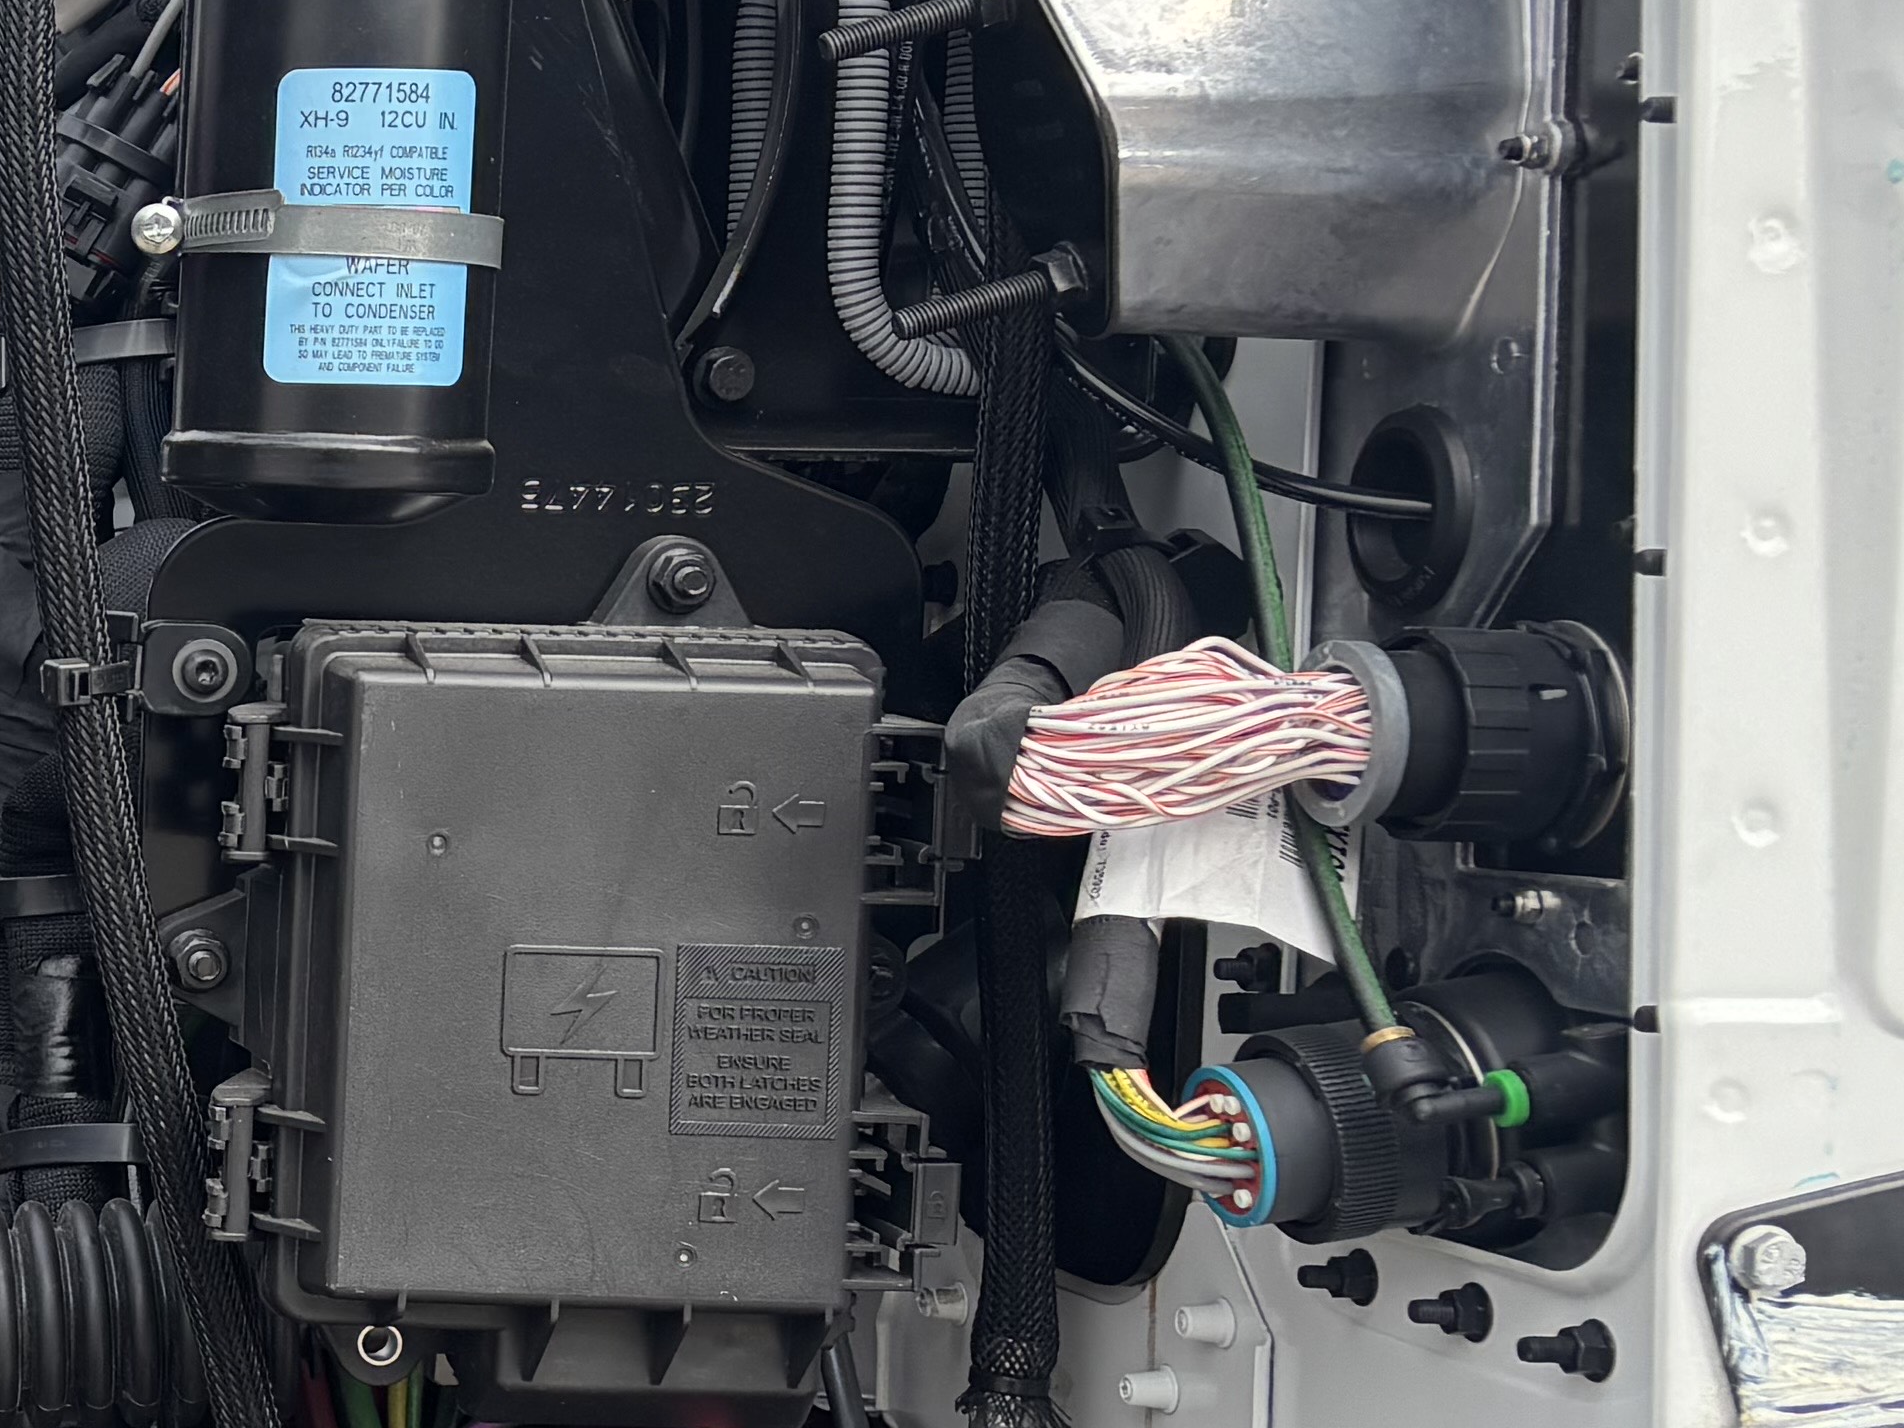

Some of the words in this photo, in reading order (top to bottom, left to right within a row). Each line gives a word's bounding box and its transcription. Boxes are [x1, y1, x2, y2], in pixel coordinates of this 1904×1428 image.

[331, 82, 430, 103] 82771584
[300, 110, 349, 127] XH-9
[381, 111, 426, 128] 12CU
[439, 112, 458, 130] IN.
[307, 166, 370, 180] SERVICE
[381, 167, 447, 181] MOISTURE
[301, 183, 371, 196] INDICATOR
[381, 184, 407, 197] PER
[415, 185, 454, 198] COLOR
[346, 258, 409, 275] WAFER
[312, 282, 386, 297] CONNECT
[396, 283, 435, 299] INLET
[312, 303, 332, 317] TO
[345, 303, 435, 320] CONDENSER
[290, 324, 306, 333] THIS
[309, 324, 334, 334] HEAVY
[339, 325, 359, 334] DUTY
[363, 325, 382, 335] PART
[388, 326, 398, 335] TO
[401, 326, 410, 336] BE
[413, 326, 445, 337] REPLACED
[312, 350, 328, 359] MAY
[332, 351, 352, 359] LEAD
[358, 351, 367, 359] TO
[318, 363, 334, 371] AND
[338, 363, 382, 372] COMPONENT
[387, 364, 415, 373] FAILURE
[730, 966, 815, 983] CAUTION
[697, 1005, 735, 1021] FOR
[740, 1006, 815, 1023] PROPER
[687, 1024, 775, 1042] WEATHER
[779, 1028, 824, 1044] SEAL
[717, 1053, 792, 1071] ENSURE
[686, 1073, 735, 1089] BOTH
[740, 1075, 822, 1092] LATCHES
[688, 1094, 725, 1109] ARE
[729, 1094, 818, 1112] ENGAGED
